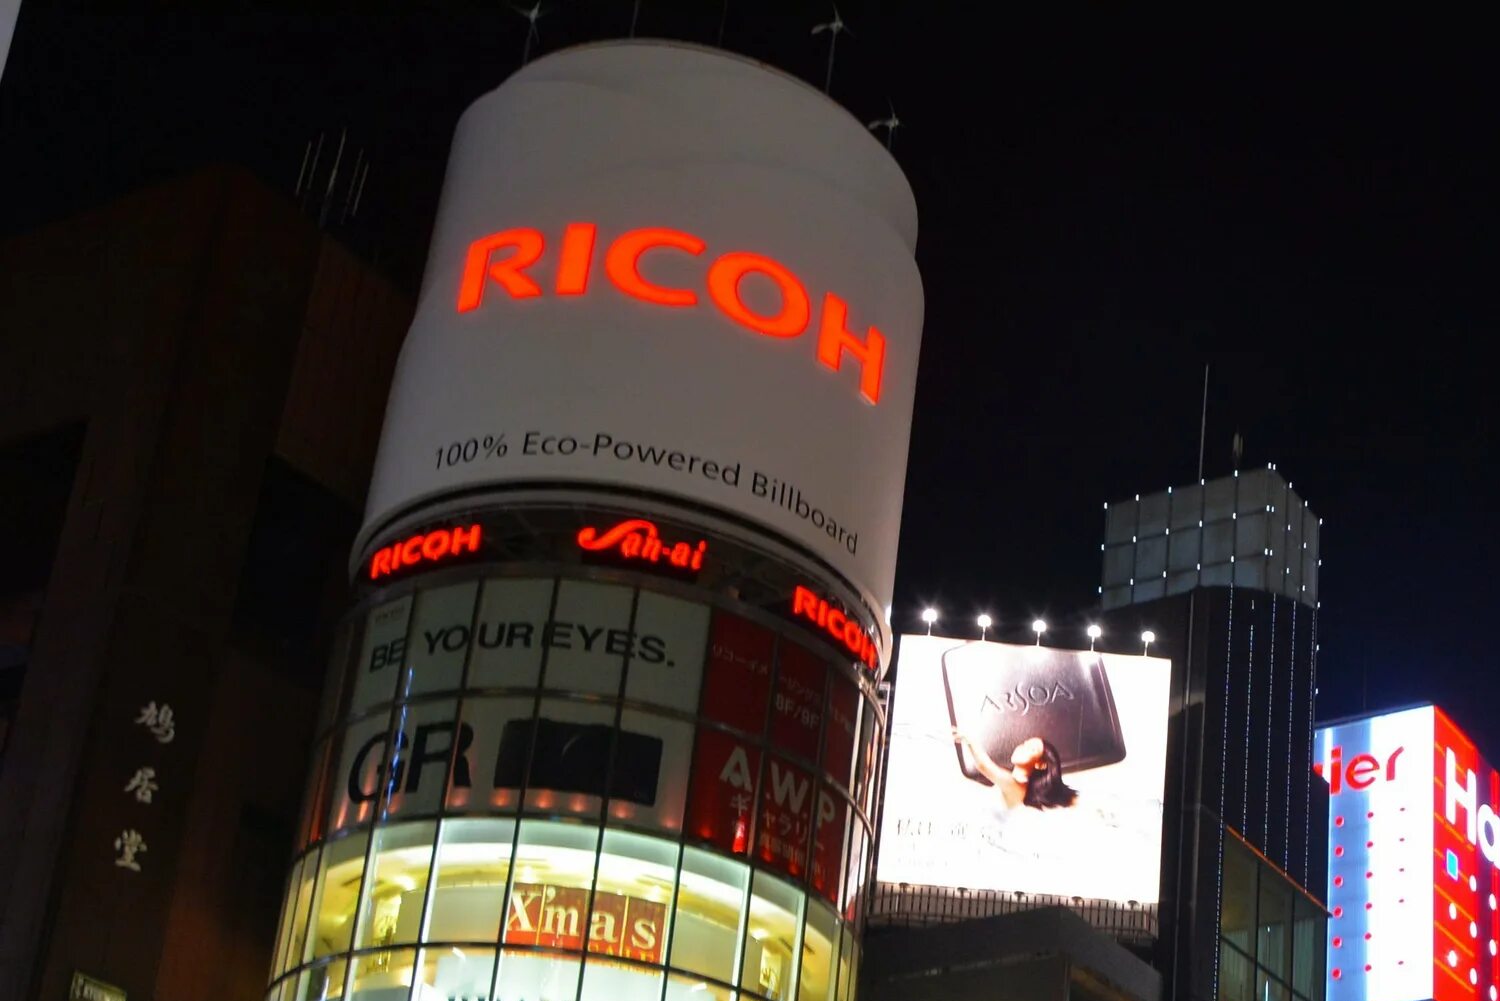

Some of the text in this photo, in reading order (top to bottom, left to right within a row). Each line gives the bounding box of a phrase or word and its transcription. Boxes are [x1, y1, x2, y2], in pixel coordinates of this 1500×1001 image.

[456, 222, 886, 406] RICOH
[434, 432, 858, 556] 100% Eco-Powered Billboard
[369, 524, 482, 580] RICOH
[577, 518, 708, 571] San-ai
[368, 622, 676, 671] BE YOUR EYES.
[793, 584, 878, 671] RICOH
[980, 680, 1074, 715] ARSOA
[348, 719, 475, 804] GR
[1314, 744, 1405, 797] ier
[505, 890, 656, 950] X'mas
